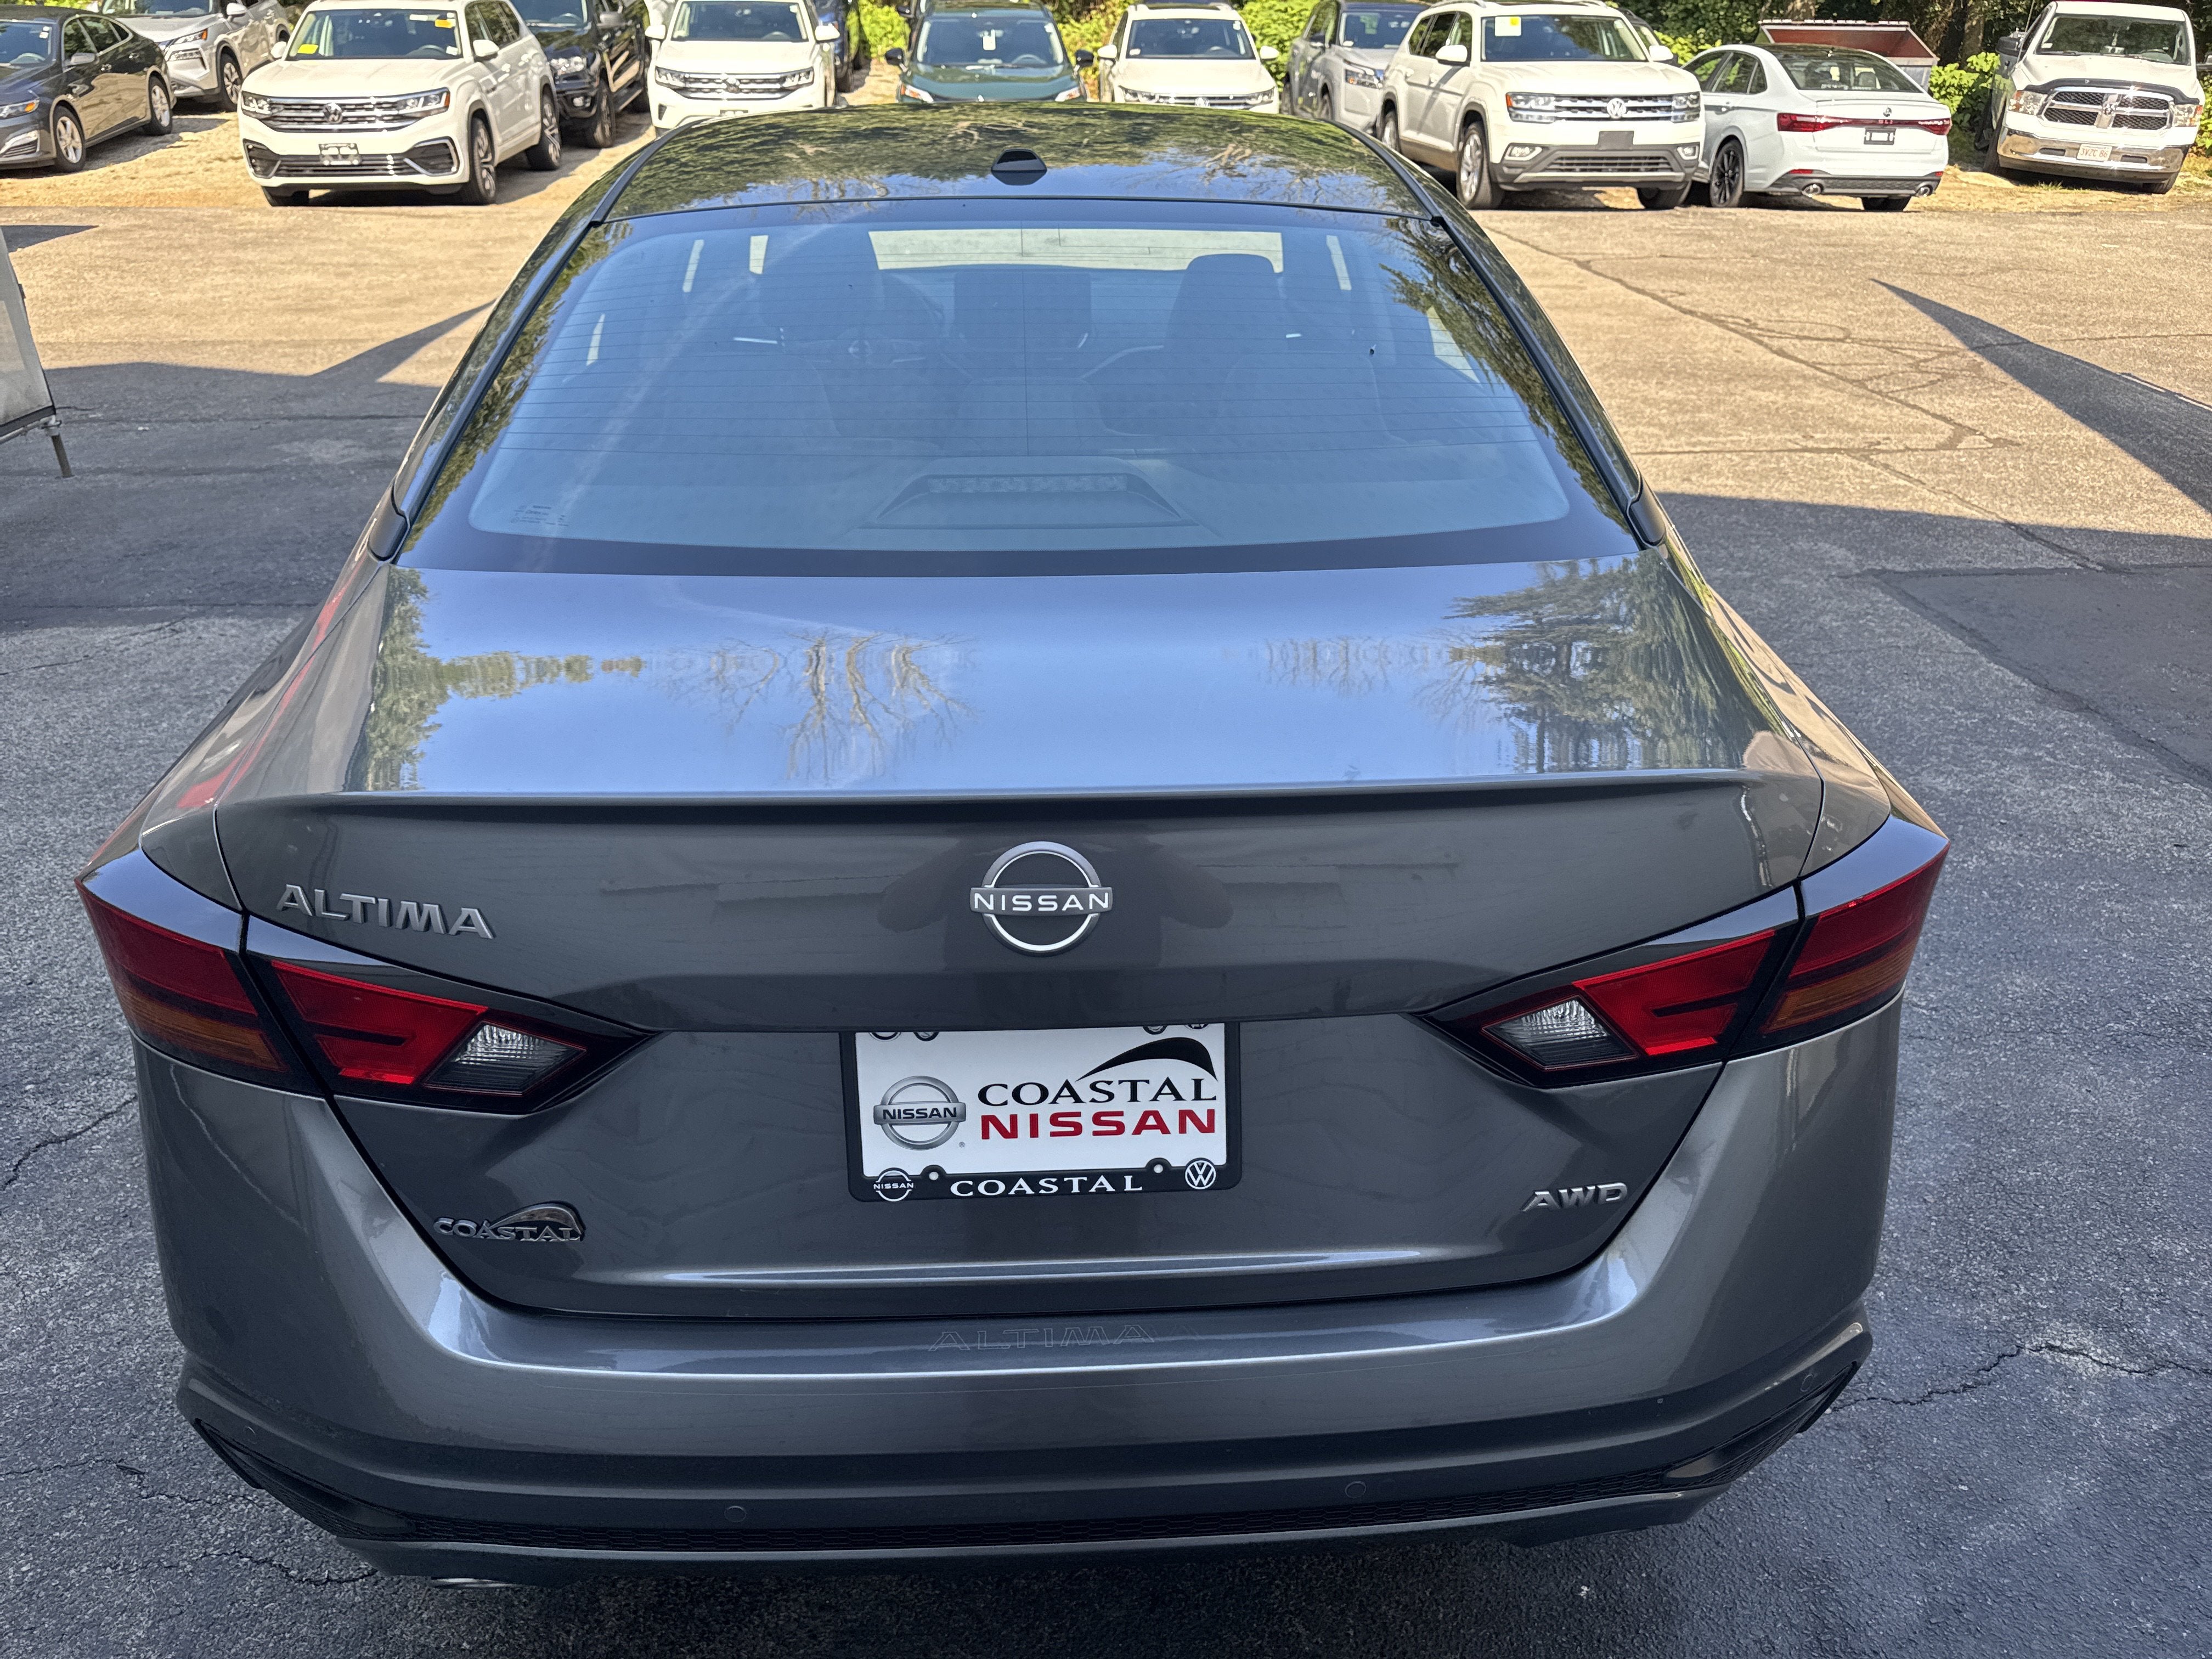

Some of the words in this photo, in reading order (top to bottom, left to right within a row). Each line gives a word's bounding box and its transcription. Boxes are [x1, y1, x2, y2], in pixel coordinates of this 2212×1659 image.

[276, 884, 494, 940] ALTIMA
[974, 892, 1109, 911] NISSAN
[978, 1077, 1217, 1107] COASTAL
[883, 1107, 957, 1120] NISSAN
[981, 1109, 1215, 1140] NISSAN
[950, 1175, 1143, 1197] COASTAL
[1520, 1182, 1627, 1211] AWD
[433, 1217, 580, 1242] COASTAL
[928, 1324, 1154, 1352] ALTIMA
